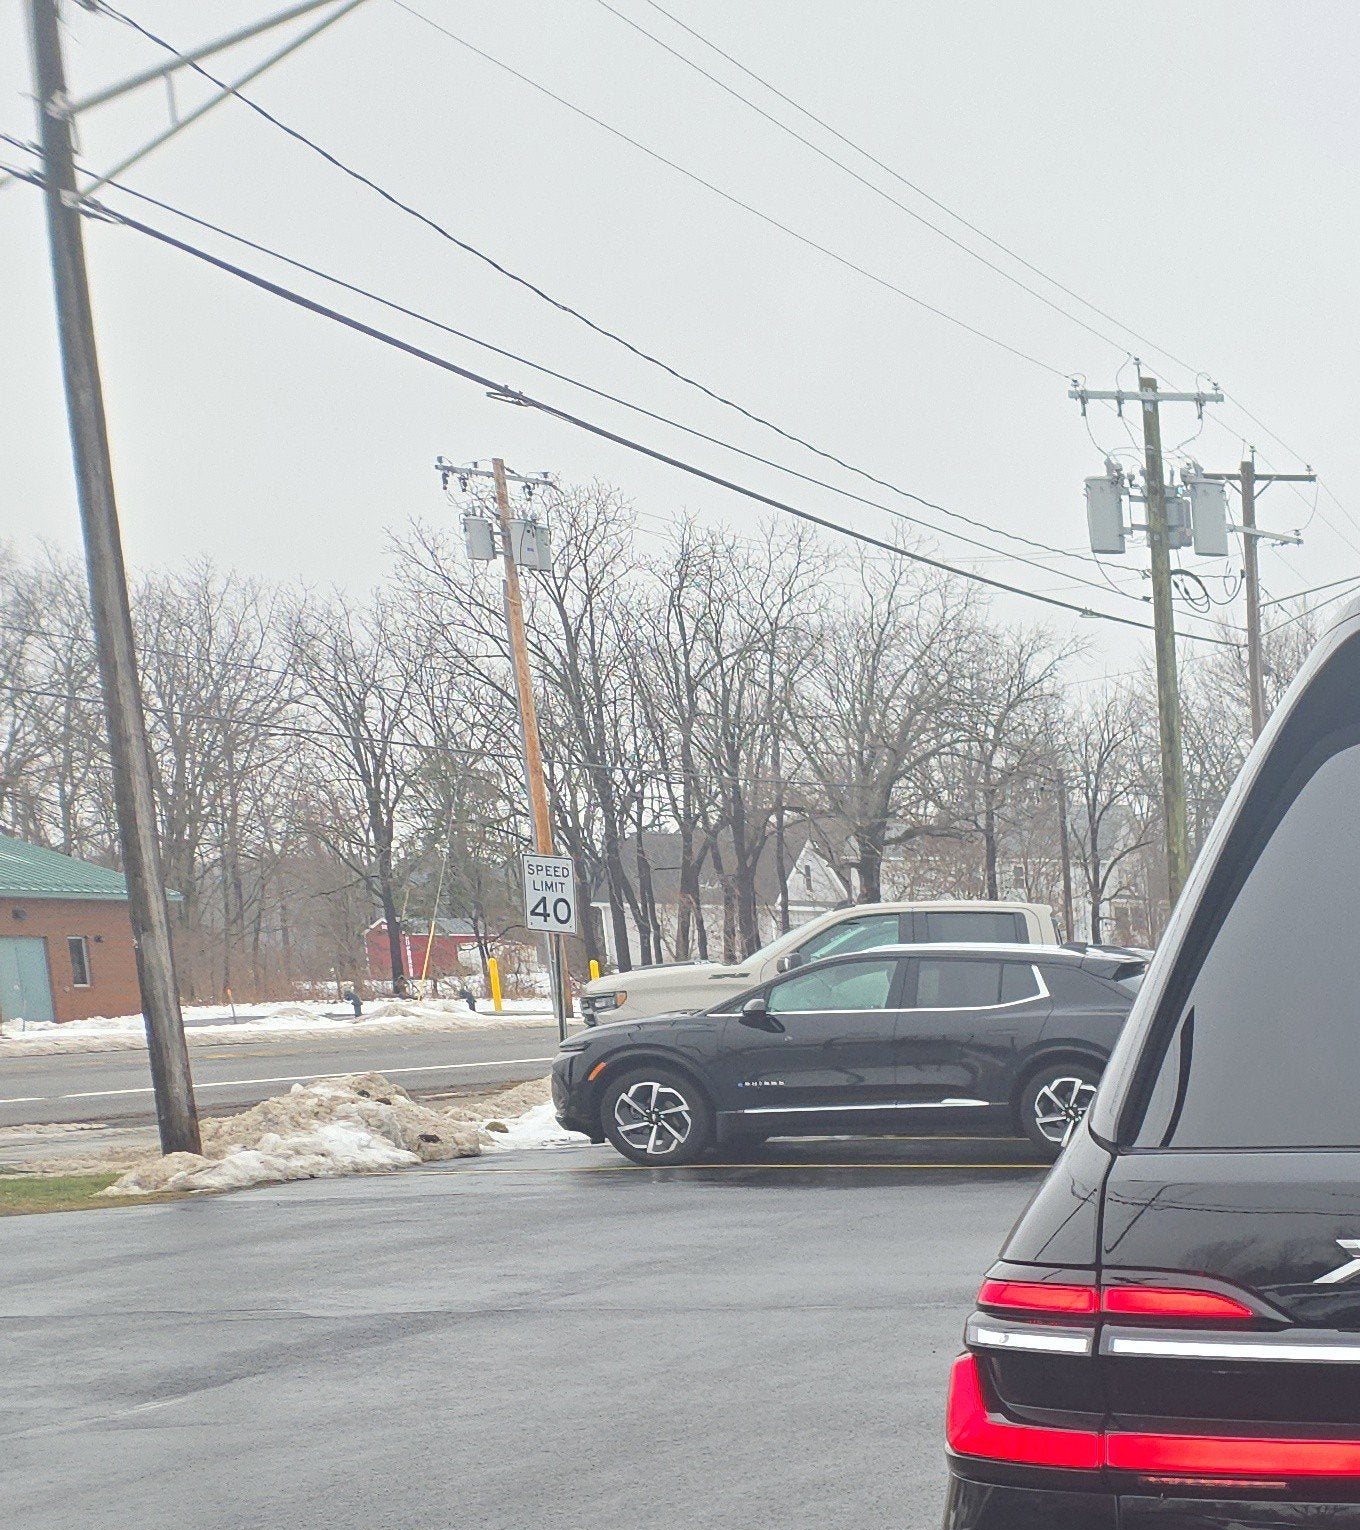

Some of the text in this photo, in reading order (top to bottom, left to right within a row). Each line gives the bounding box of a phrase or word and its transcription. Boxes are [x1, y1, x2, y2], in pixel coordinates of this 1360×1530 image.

[527, 864, 570, 878] SPEED
[532, 880, 566, 893] LIMIT
[529, 896, 572, 925] 40
